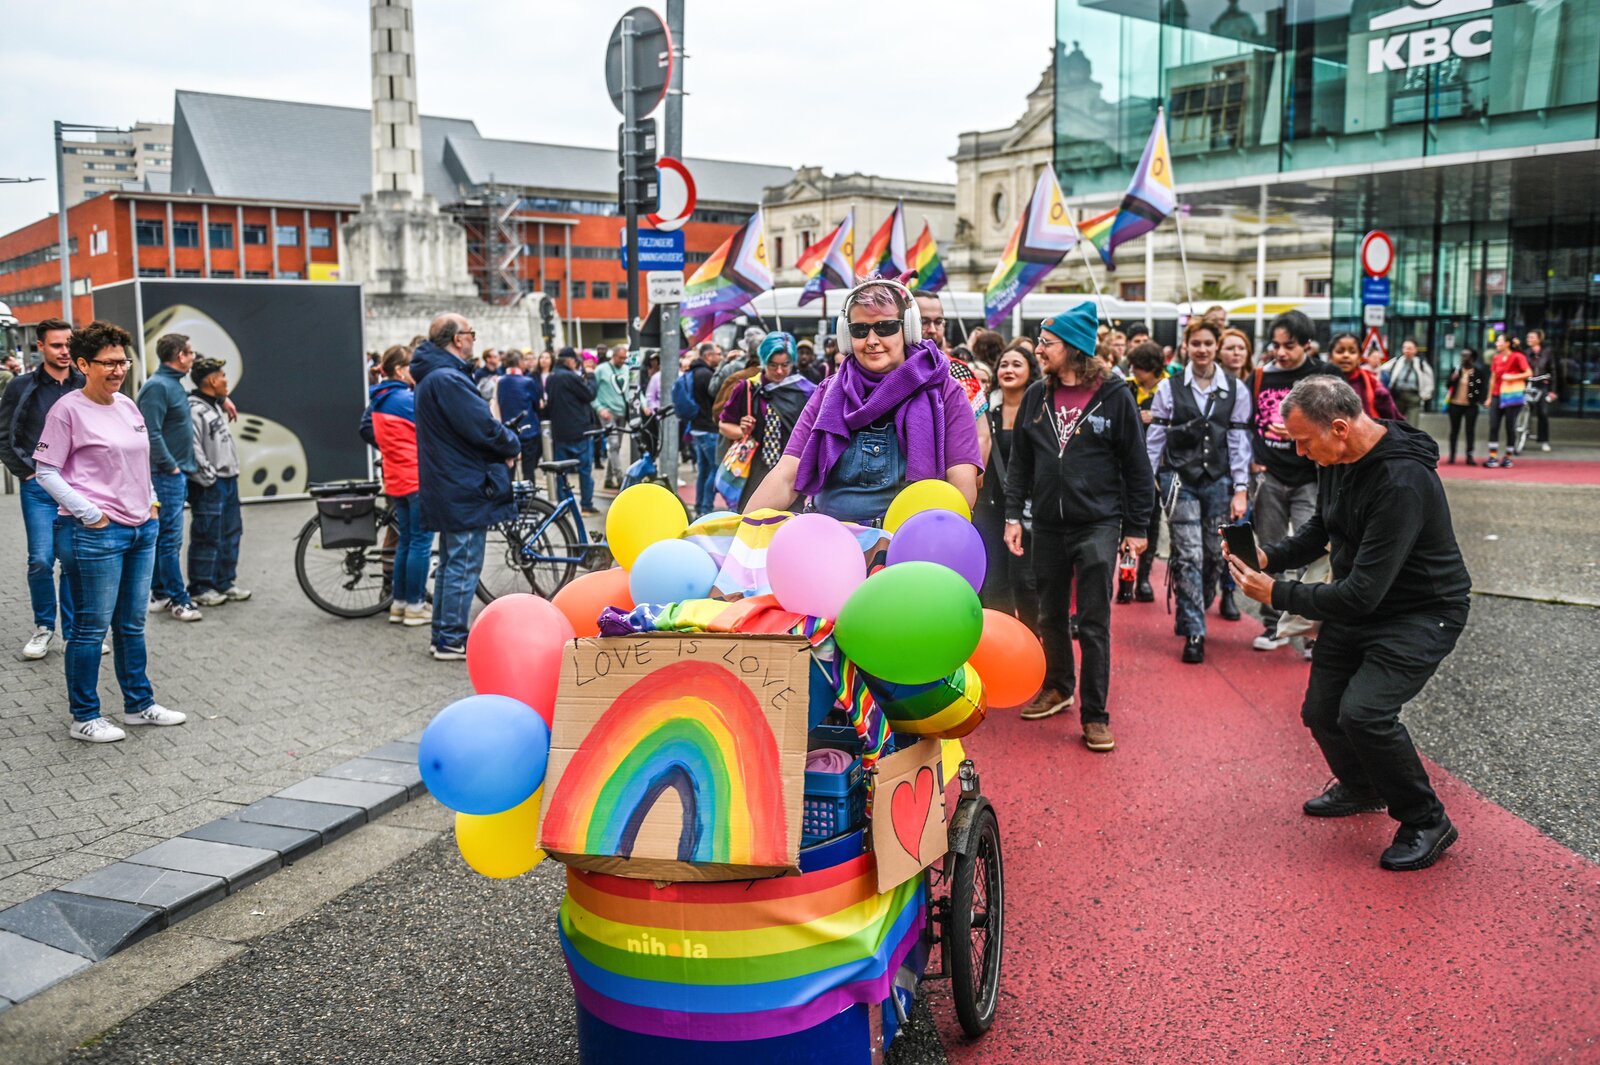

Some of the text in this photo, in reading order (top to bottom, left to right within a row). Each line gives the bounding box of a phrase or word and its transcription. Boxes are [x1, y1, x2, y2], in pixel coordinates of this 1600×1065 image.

[1367, 17, 1493, 75] KBC
[573, 639, 797, 710] LOVE IS LOVE
